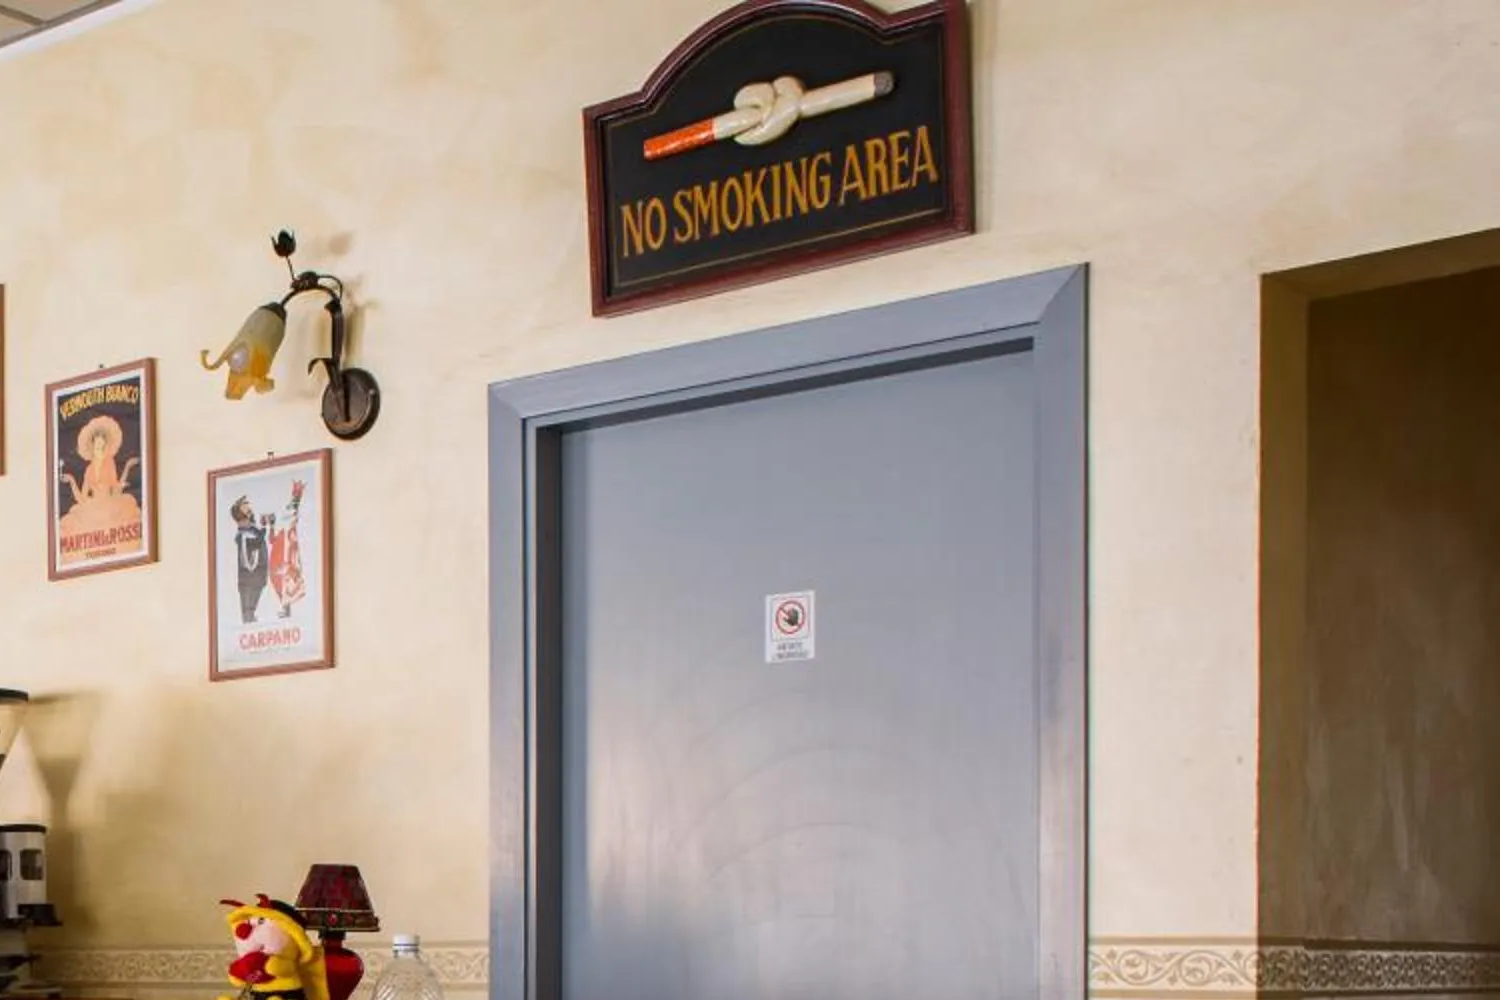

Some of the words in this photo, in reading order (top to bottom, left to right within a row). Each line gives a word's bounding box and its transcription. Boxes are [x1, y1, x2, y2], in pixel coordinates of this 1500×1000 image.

[619, 196, 668, 259] NO
[672, 150, 833, 245] SMOKING
[838, 124, 940, 207] AREA
[238, 627, 301, 650] CARPANO
